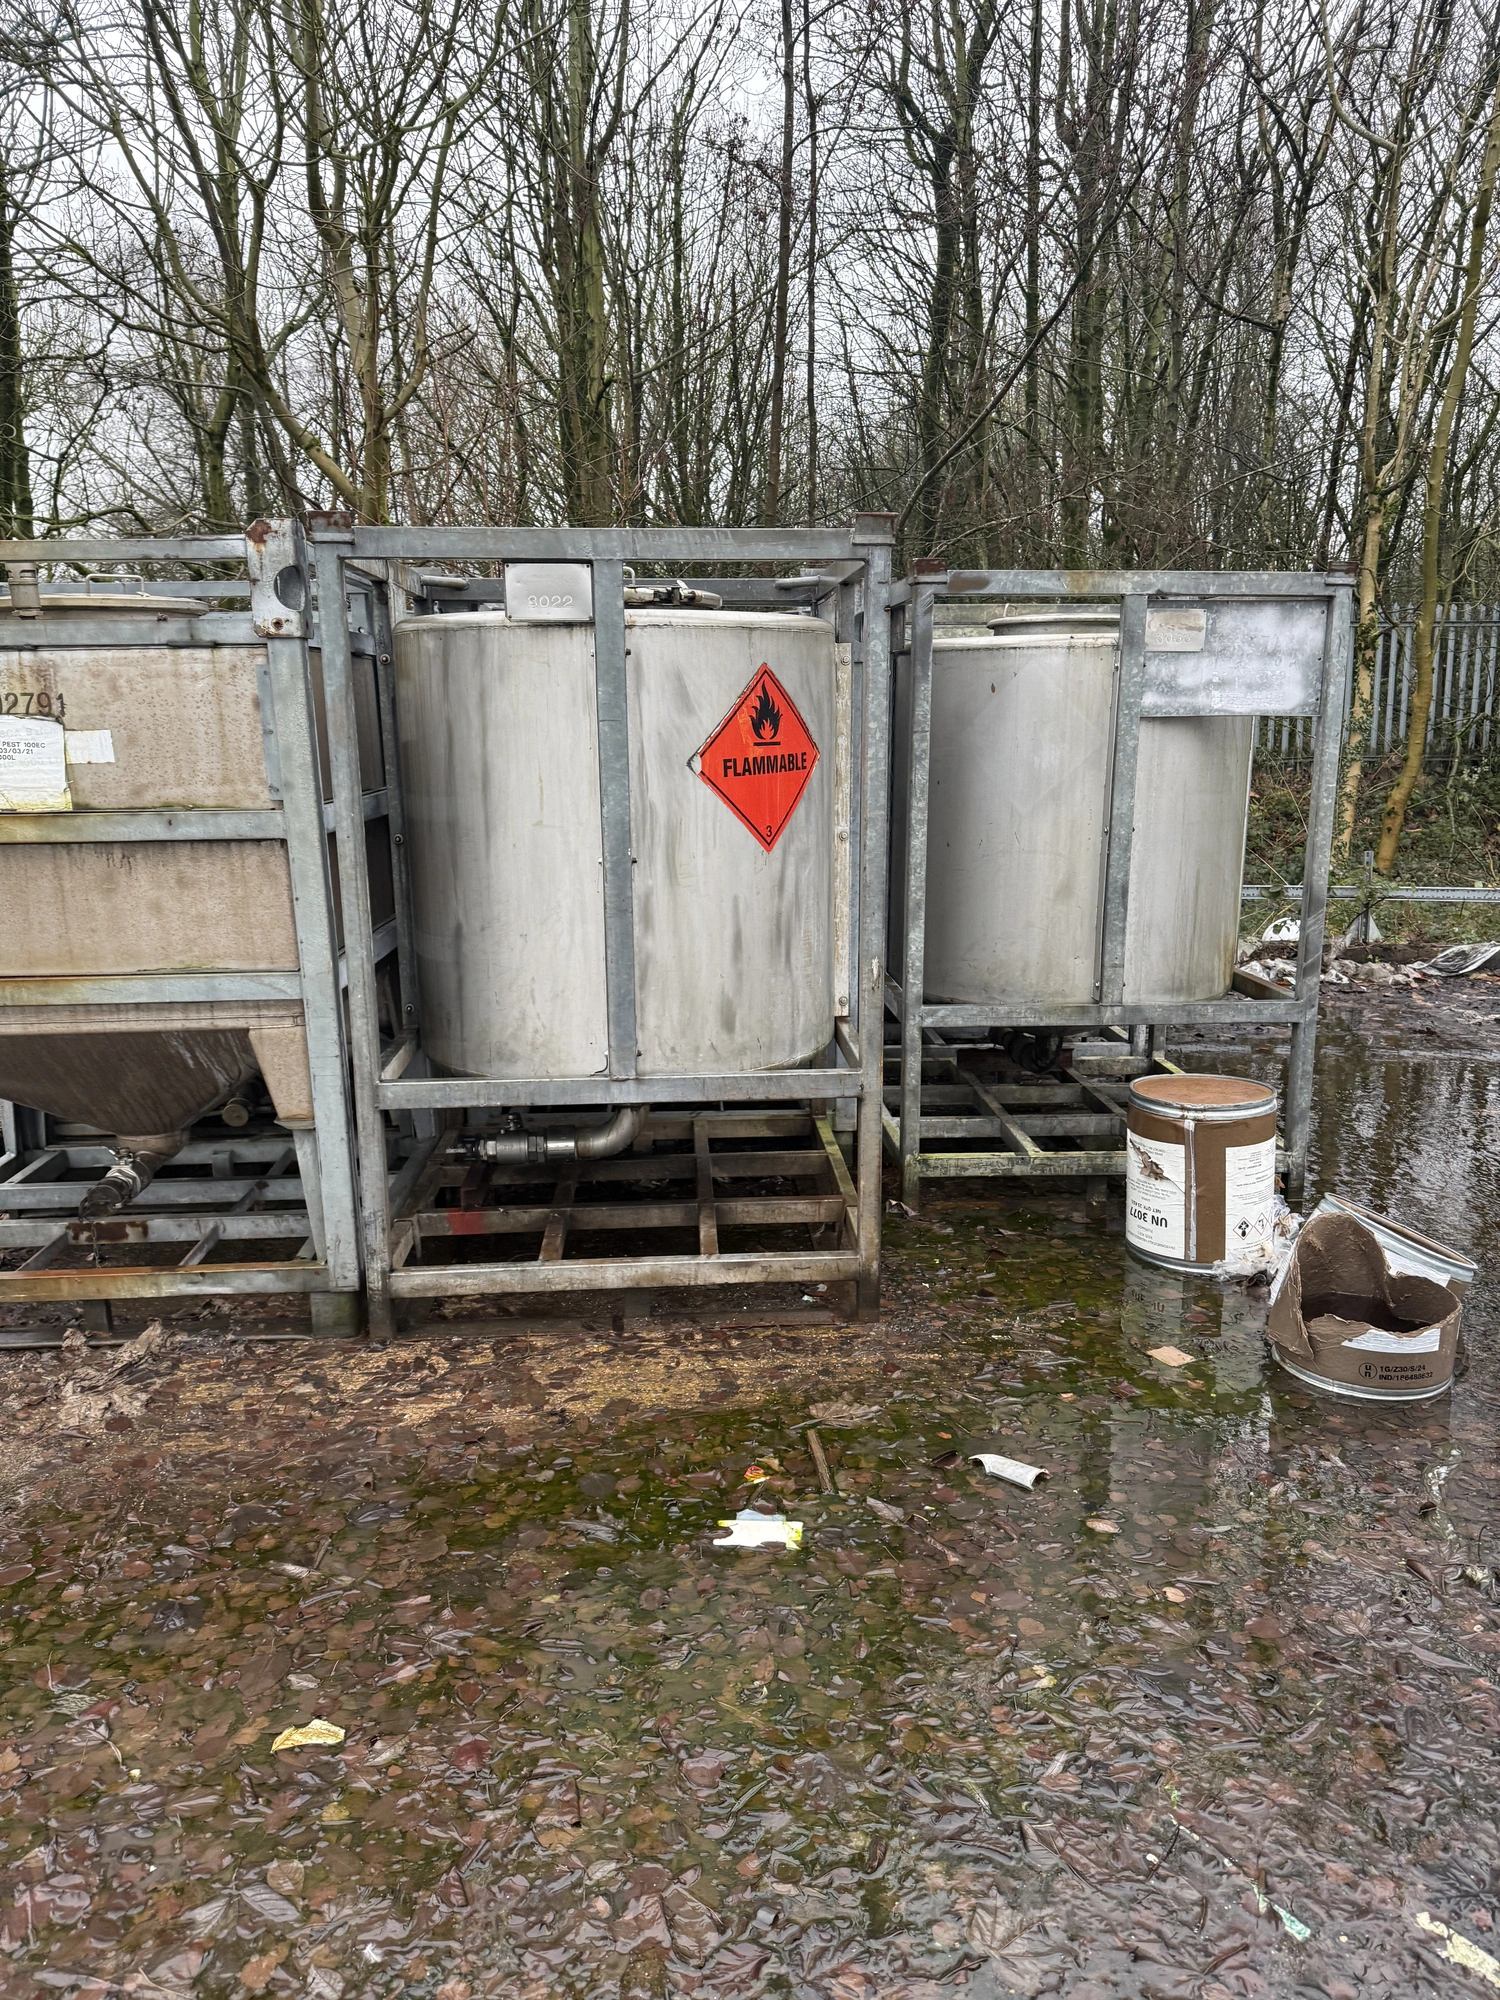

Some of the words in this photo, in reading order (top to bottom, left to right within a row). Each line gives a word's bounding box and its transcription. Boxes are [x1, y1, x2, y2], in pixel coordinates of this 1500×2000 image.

[528, 595, 573, 608] 3022
[0, 692, 66, 717] 2791
[723, 751, 807, 777] FLAMMABLE
[765, 825, 773, 837] 3
[1130, 1206, 1148, 1223] 3077
[1151, 1215, 1168, 1228] UN
